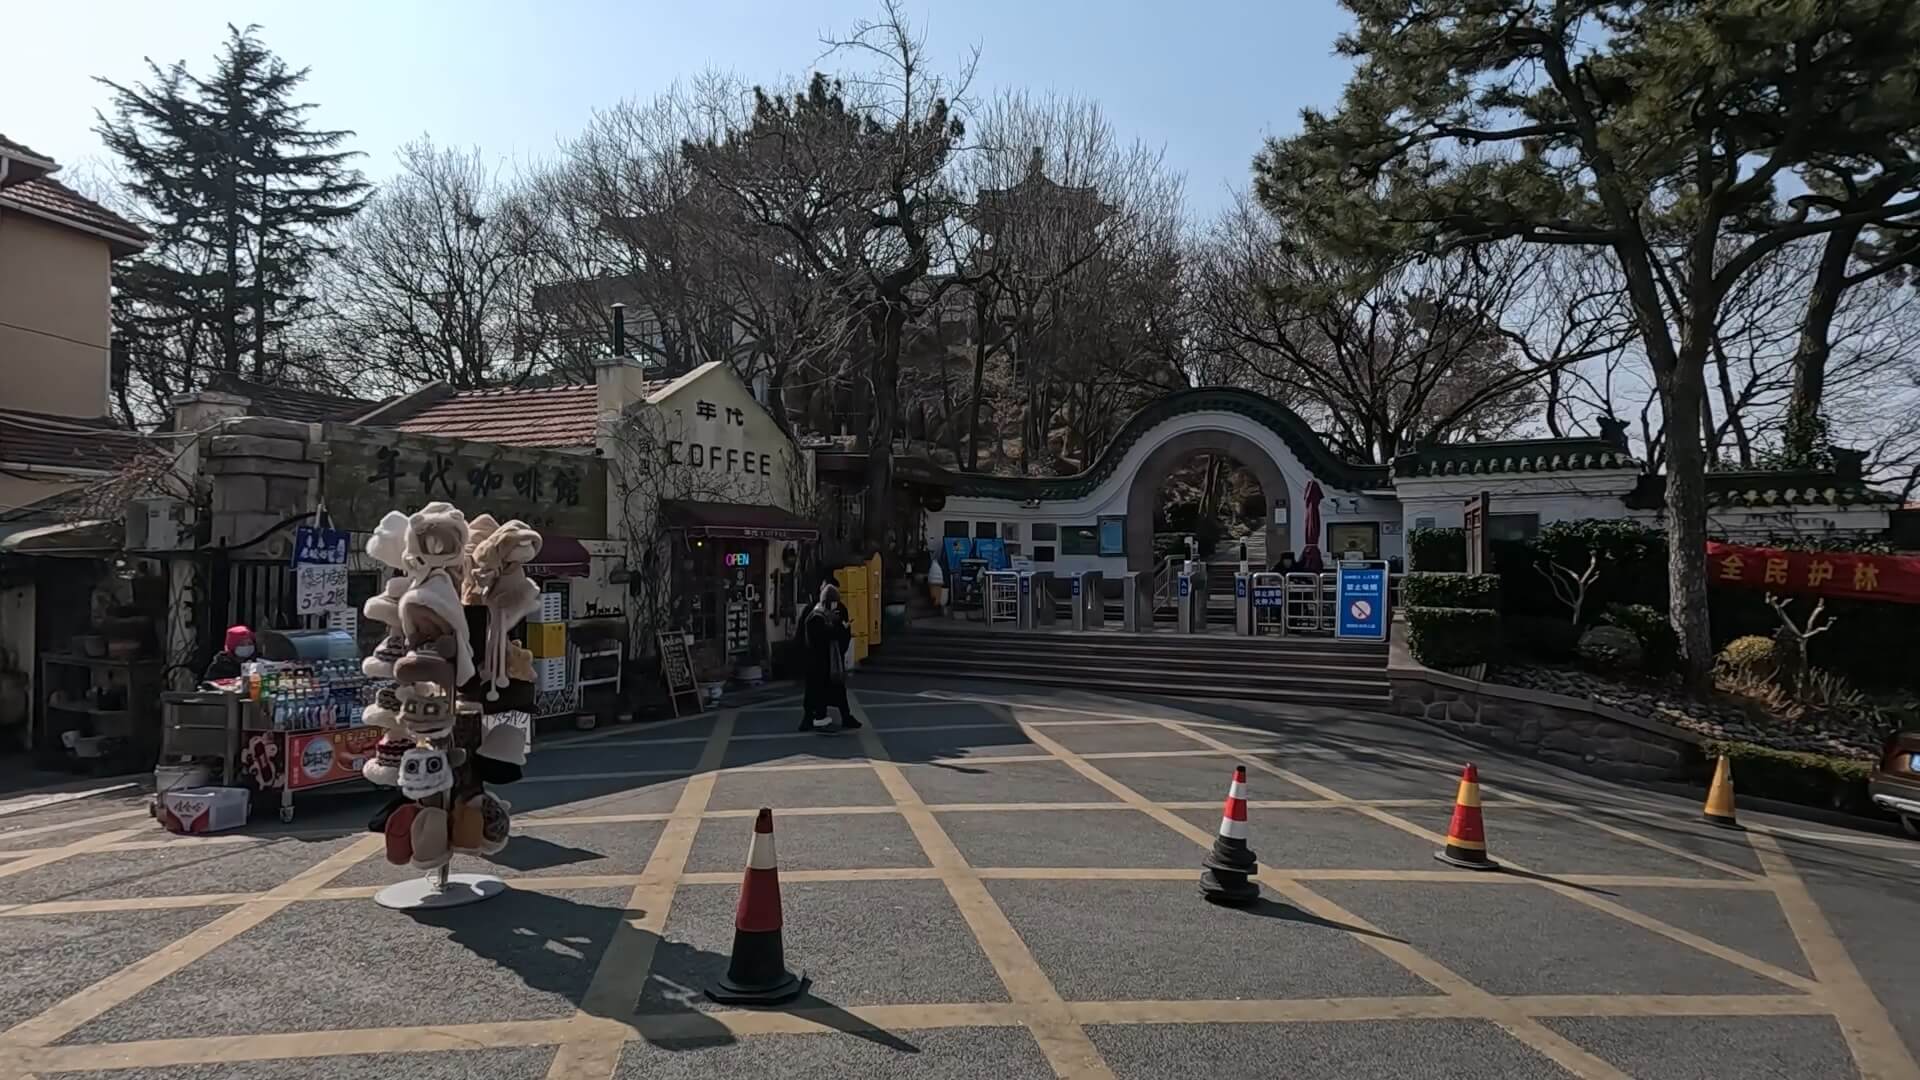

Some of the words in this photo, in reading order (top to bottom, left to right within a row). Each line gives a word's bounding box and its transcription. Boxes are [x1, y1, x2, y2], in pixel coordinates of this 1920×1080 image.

[696, 400, 744, 426] 年代
[669, 440, 771, 476] COFFEE
[726, 553, 750, 566] OPEN
[1719, 553, 1879, 592] 全民护林
[1181, 581, 1187, 594] 入口
[1239, 581, 1245, 595] 入口
